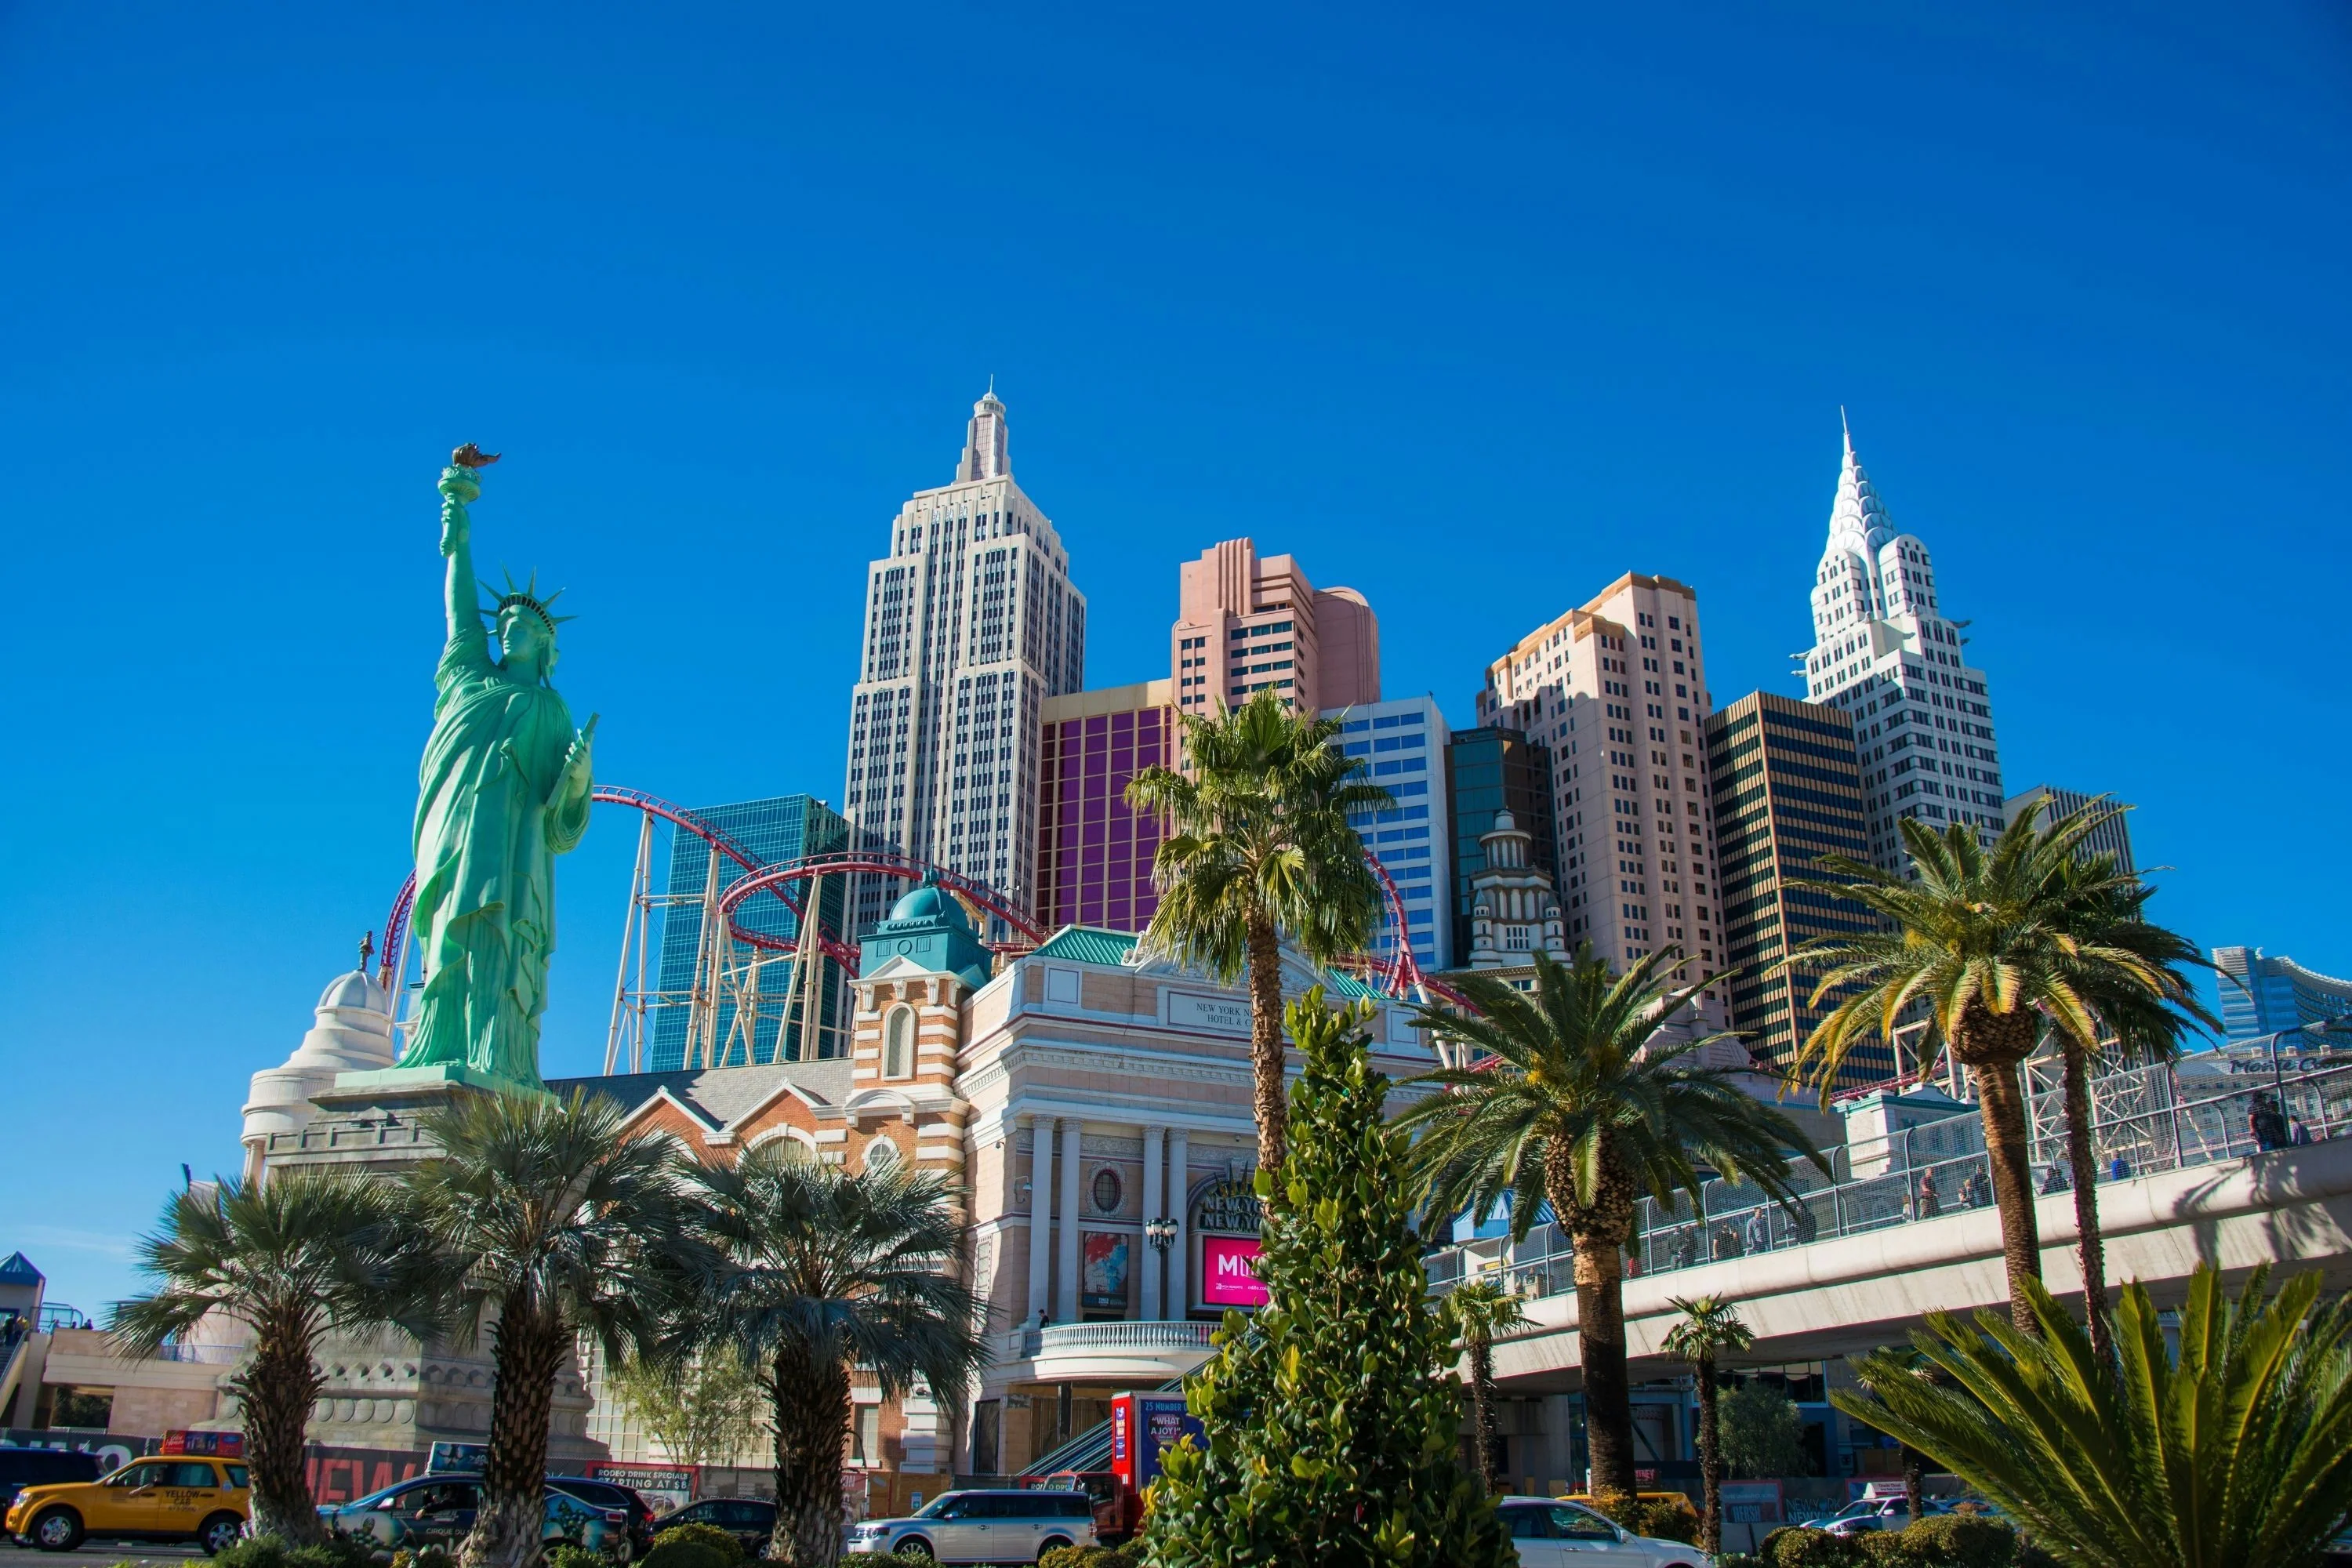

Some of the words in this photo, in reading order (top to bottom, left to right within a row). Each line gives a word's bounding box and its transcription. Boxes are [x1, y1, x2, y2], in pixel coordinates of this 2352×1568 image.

[1196, 1003, 1215, 1012] NEW
[1218, 1006, 1240, 1016] YORK
[1207, 1014, 1233, 1025] HOTEL
[1204, 1195, 1240, 1210] NEW
[1243, 1197, 1260, 1213] YO
[1204, 1213, 1240, 1229] NEW
[1243, 1215, 1261, 1230] YO
[1145, 1402, 1153, 1411] 25
[1156, 1402, 1181, 1411] NUMBER
[653, 1472, 688, 1480] SPECIALS
[657, 1480, 670, 1489] AT
[674, 1480, 688, 1490] $8
